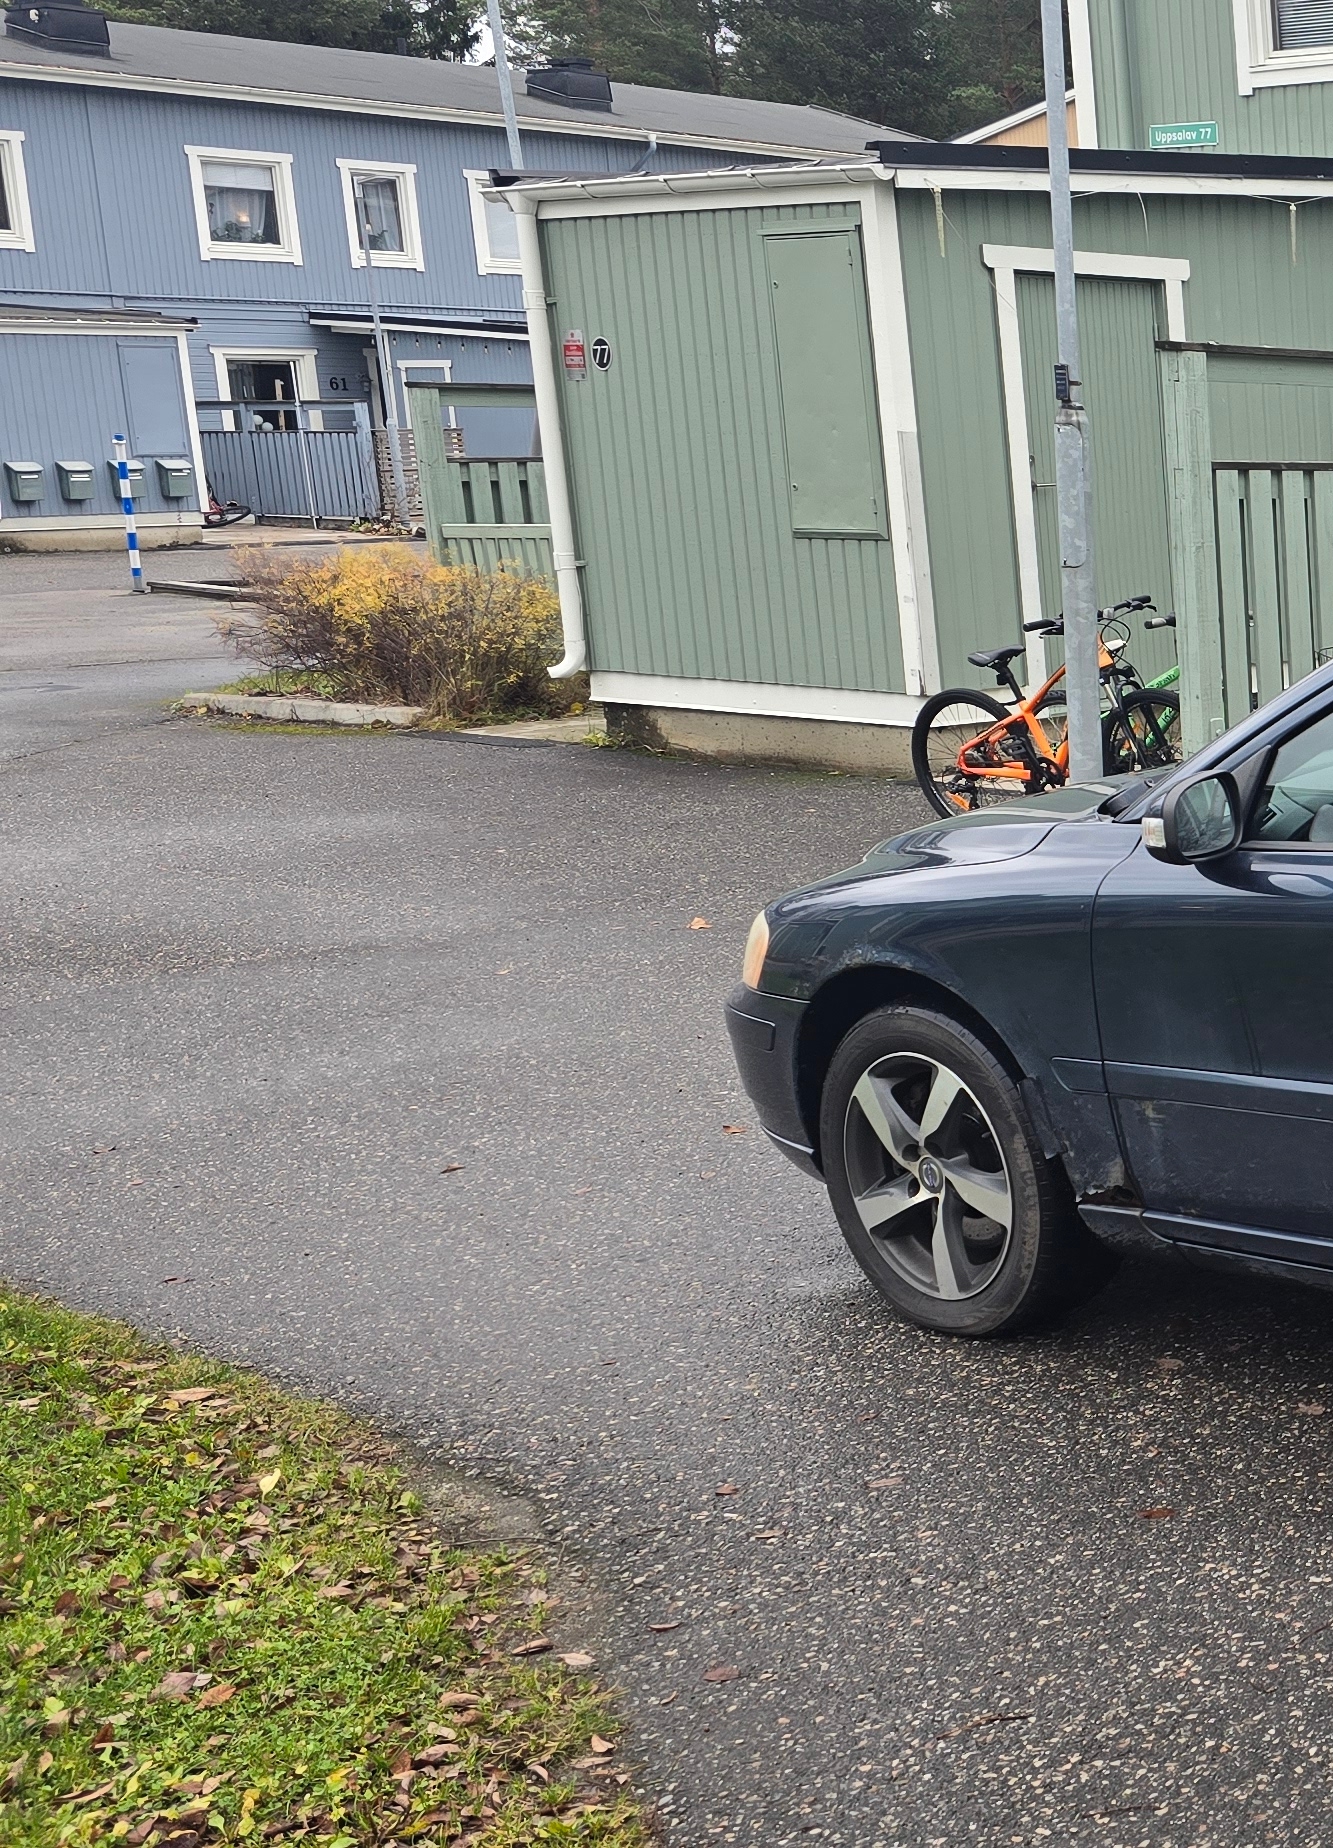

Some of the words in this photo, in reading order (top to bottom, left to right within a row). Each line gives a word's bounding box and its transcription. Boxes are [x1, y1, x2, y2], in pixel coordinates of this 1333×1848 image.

[1155, 129, 1197, 144] Uppsalav
[1199, 128, 1211, 139] 77
[592, 345, 609, 364] 77
[329, 376, 349, 391] 61
